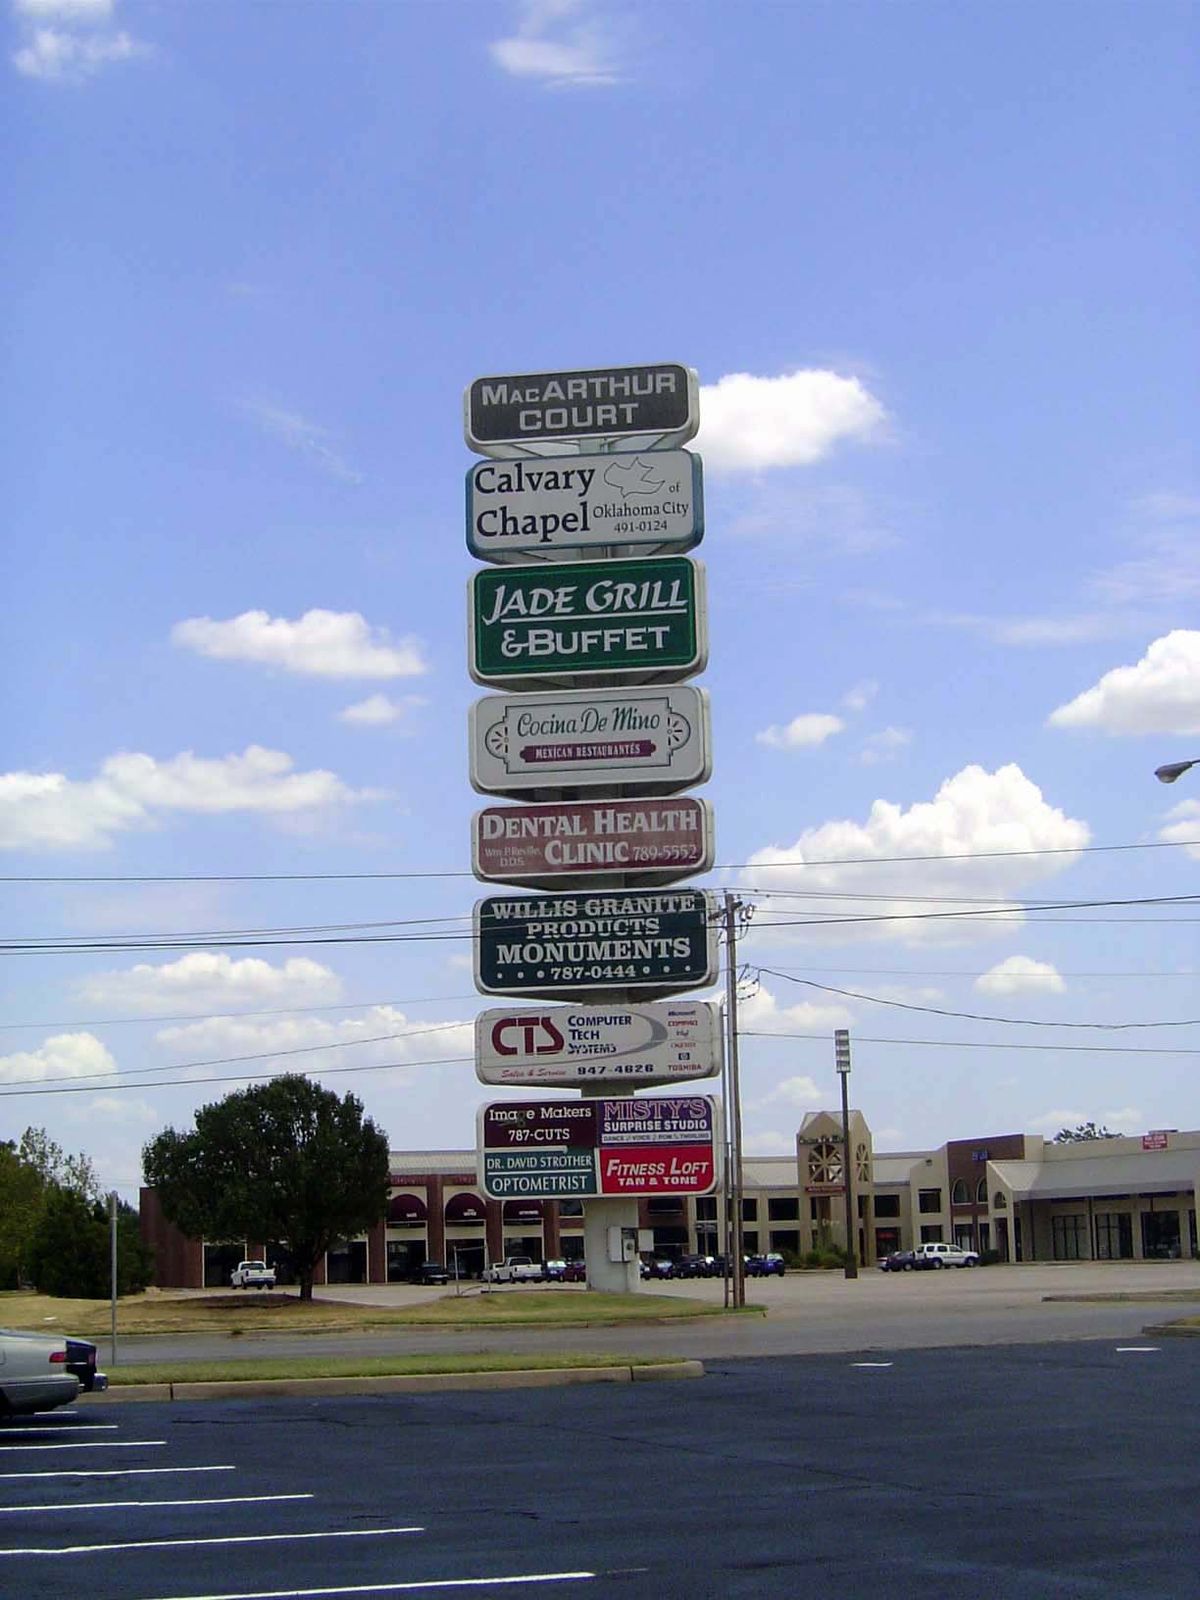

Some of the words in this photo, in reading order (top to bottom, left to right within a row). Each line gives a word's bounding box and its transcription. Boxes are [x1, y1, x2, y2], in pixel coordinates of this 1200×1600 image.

[519, 402, 640, 431] COURT
[474, 463, 596, 497] Calvary
[668, 481, 682, 493] of
[592, 502, 661, 519] Oklahoma
[661, 501, 690, 517] City
[476, 501, 591, 543] Chapel
[613, 519, 669, 534] 491-0124
[481, 584, 578, 626] JADE
[585, 579, 689, 613] GRILL
[516, 712, 578, 738] Cocina
[578, 707, 608, 734] De
[481, 813, 588, 840] DENTAL
[592, 808, 698, 836] HEALTH
[544, 839, 630, 866] CLINIC
[632, 843, 698, 861] 789-5552
[491, 899, 578, 920] WILLIS
[584, 894, 696, 917] GRANITE
[525, 917, 661, 940] PRODUCTS
[496, 937, 692, 965] MONUMENTS
[550, 964, 637, 981] 787-0444
[567, 1014, 633, 1028] COMPUTER
[491, 1016, 565, 1057] CTS
[569, 1029, 600, 1041] TECH
[668, 1063, 702, 1072] TOSHIBA
[540, 1106, 593, 1120] Makers
[602, 1098, 708, 1121] MISTY'S
[508, 1128, 571, 1142] 787-CUTS
[603, 1120, 662, 1132] SURPRISE
[664, 1119, 708, 1131] STUDIO
[486, 1157, 505, 1170] DR.
[507, 1156, 538, 1169] DAVID
[540, 1154, 593, 1168] STROTHER
[606, 1158, 666, 1177] FITNESS
[669, 1157, 710, 1175] LOFT
[491, 1174, 588, 1193] OPTOMETRIST
[617, 1177, 647, 1187] TAN
[663, 1175, 699, 1186] TONE
